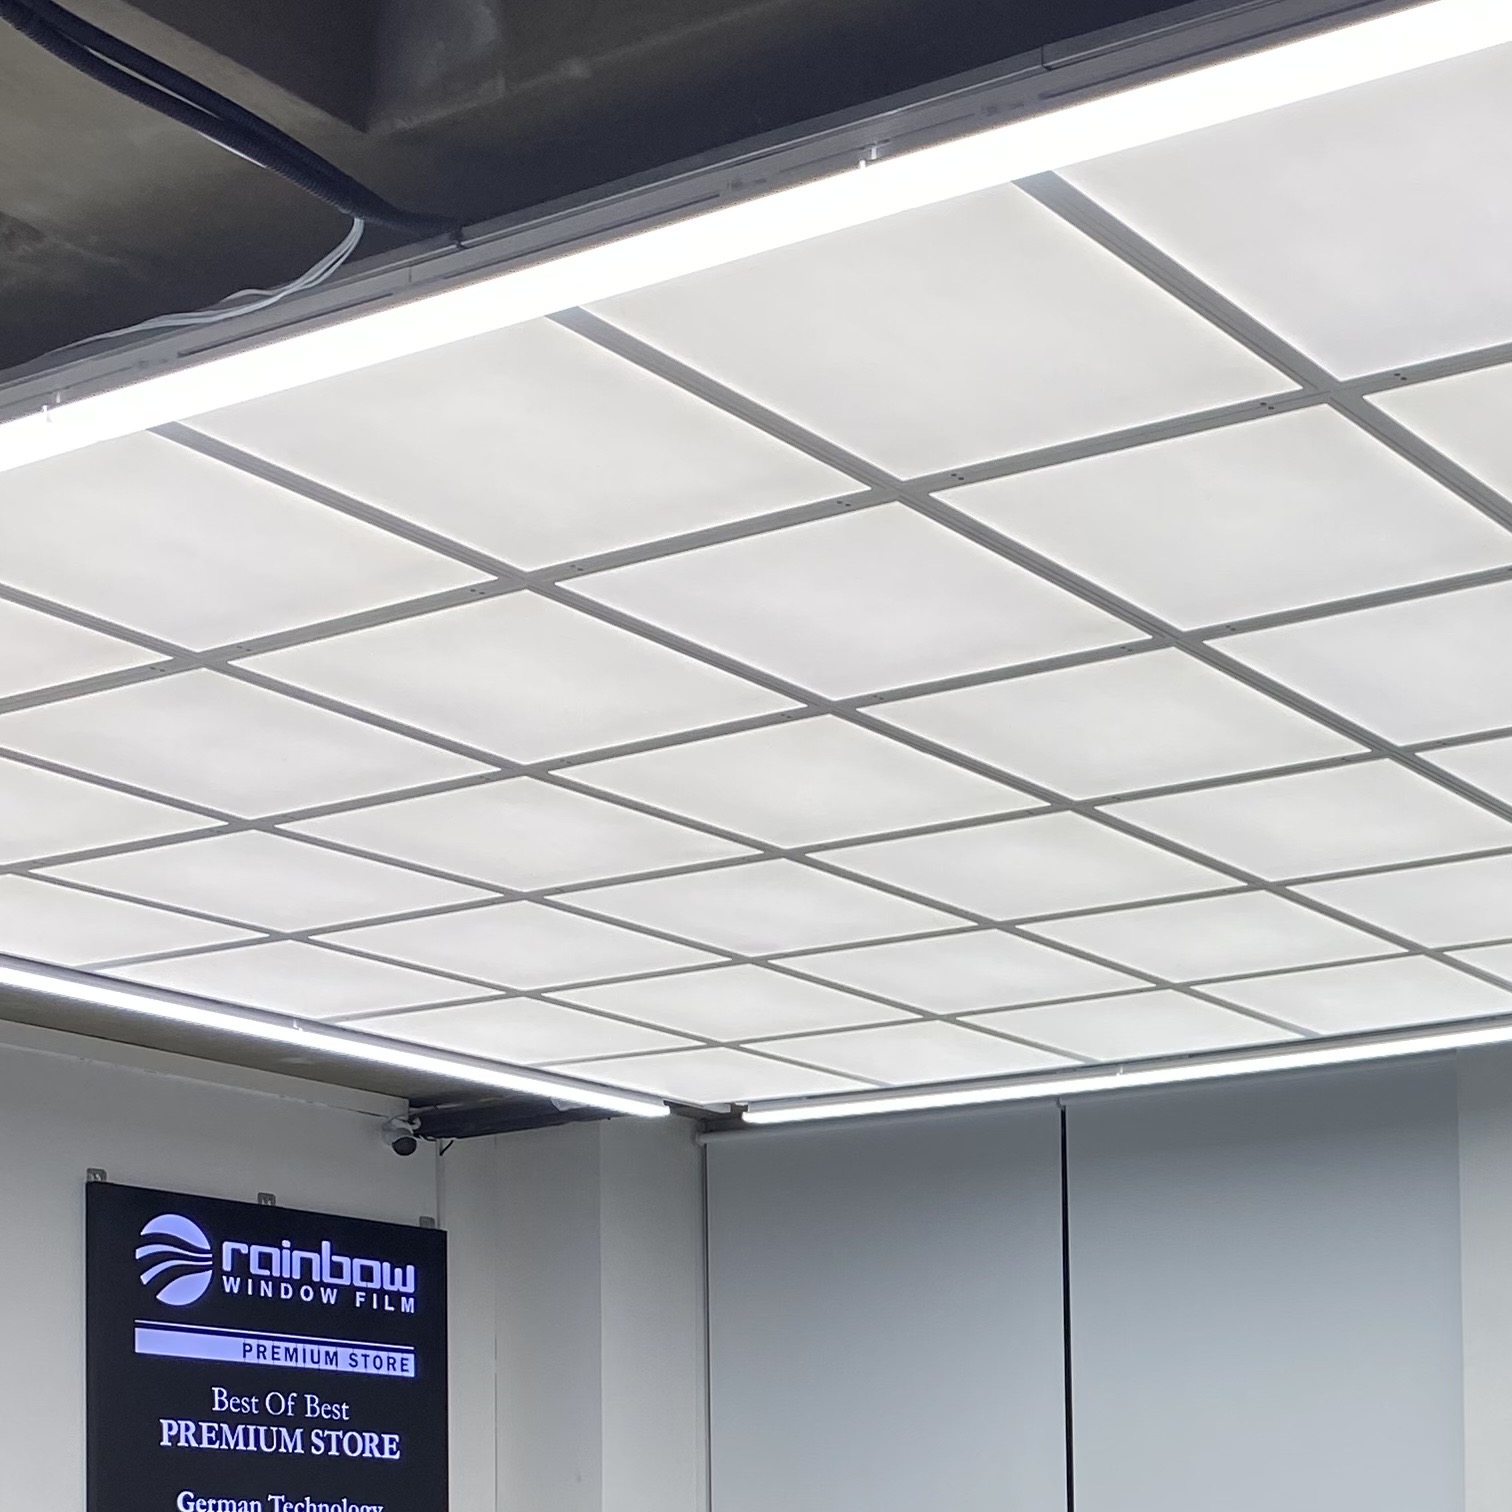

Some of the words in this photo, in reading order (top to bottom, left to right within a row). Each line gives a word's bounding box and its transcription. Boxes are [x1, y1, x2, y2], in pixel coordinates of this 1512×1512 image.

[222, 1240, 416, 1293] rainbow
[222, 1275, 338, 1305] WINDOW
[355, 1291, 416, 1314] FILM
[242, 1341, 339, 1367] PREMIUM
[348, 1352, 411, 1373] STORE
[211, 1386, 260, 1414] Best
[265, 1391, 299, 1416] Of
[304, 1394, 351, 1420] Best
[159, 1419, 305, 1454] PREMIUM
[311, 1429, 401, 1459] STORE
